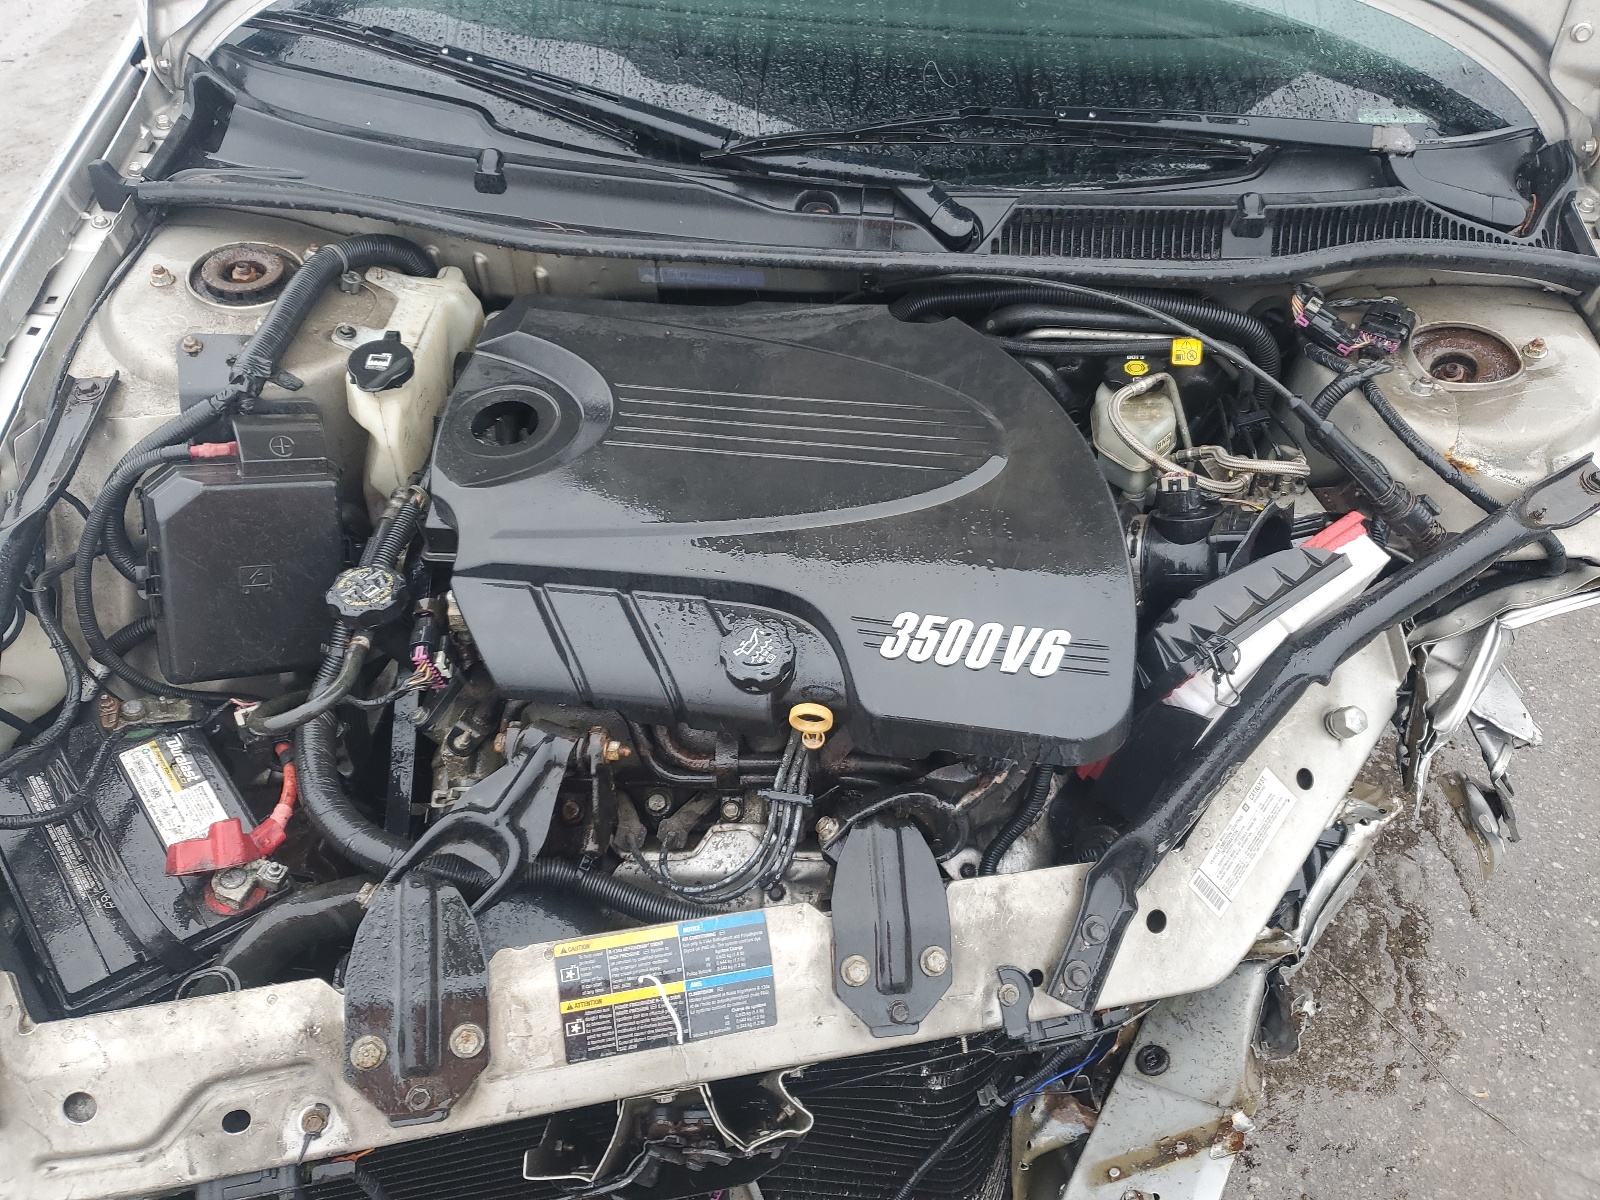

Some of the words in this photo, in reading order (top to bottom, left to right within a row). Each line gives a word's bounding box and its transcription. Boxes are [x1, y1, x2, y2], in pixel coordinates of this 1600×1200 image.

[879, 611, 1004, 671] 3500
[999, 625, 1072, 678] V6
[166, 736, 200, 782] Duralast
[1248, 775, 1267, 801] CATALYST
[682, 925, 701, 933] NOTICE
[568, 943, 590, 953] CAUTION
[574, 999, 603, 1009] ATTENTION
